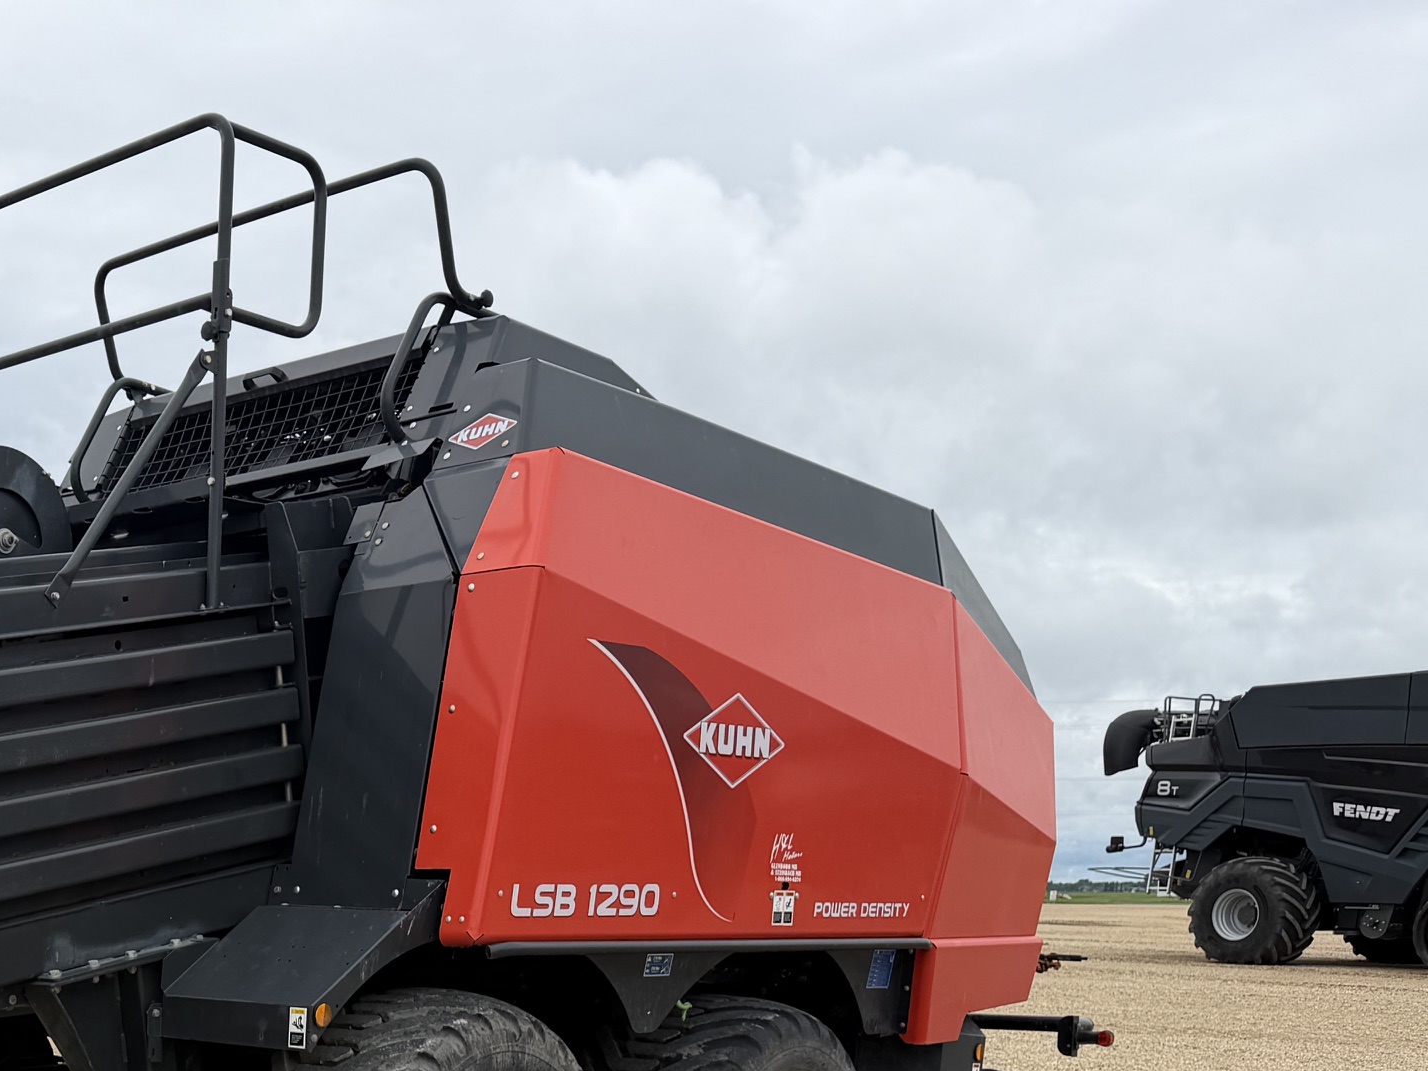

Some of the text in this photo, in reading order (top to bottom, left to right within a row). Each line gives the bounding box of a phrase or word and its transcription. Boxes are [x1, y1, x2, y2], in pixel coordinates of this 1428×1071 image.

[457, 419, 509, 443] KUHN
[699, 721, 771, 759] KUHN
[1333, 802, 1400, 822] FENDT
[510, 883, 660, 917] LSB 1290
[813, 902, 910, 918] POWER DENSITY
